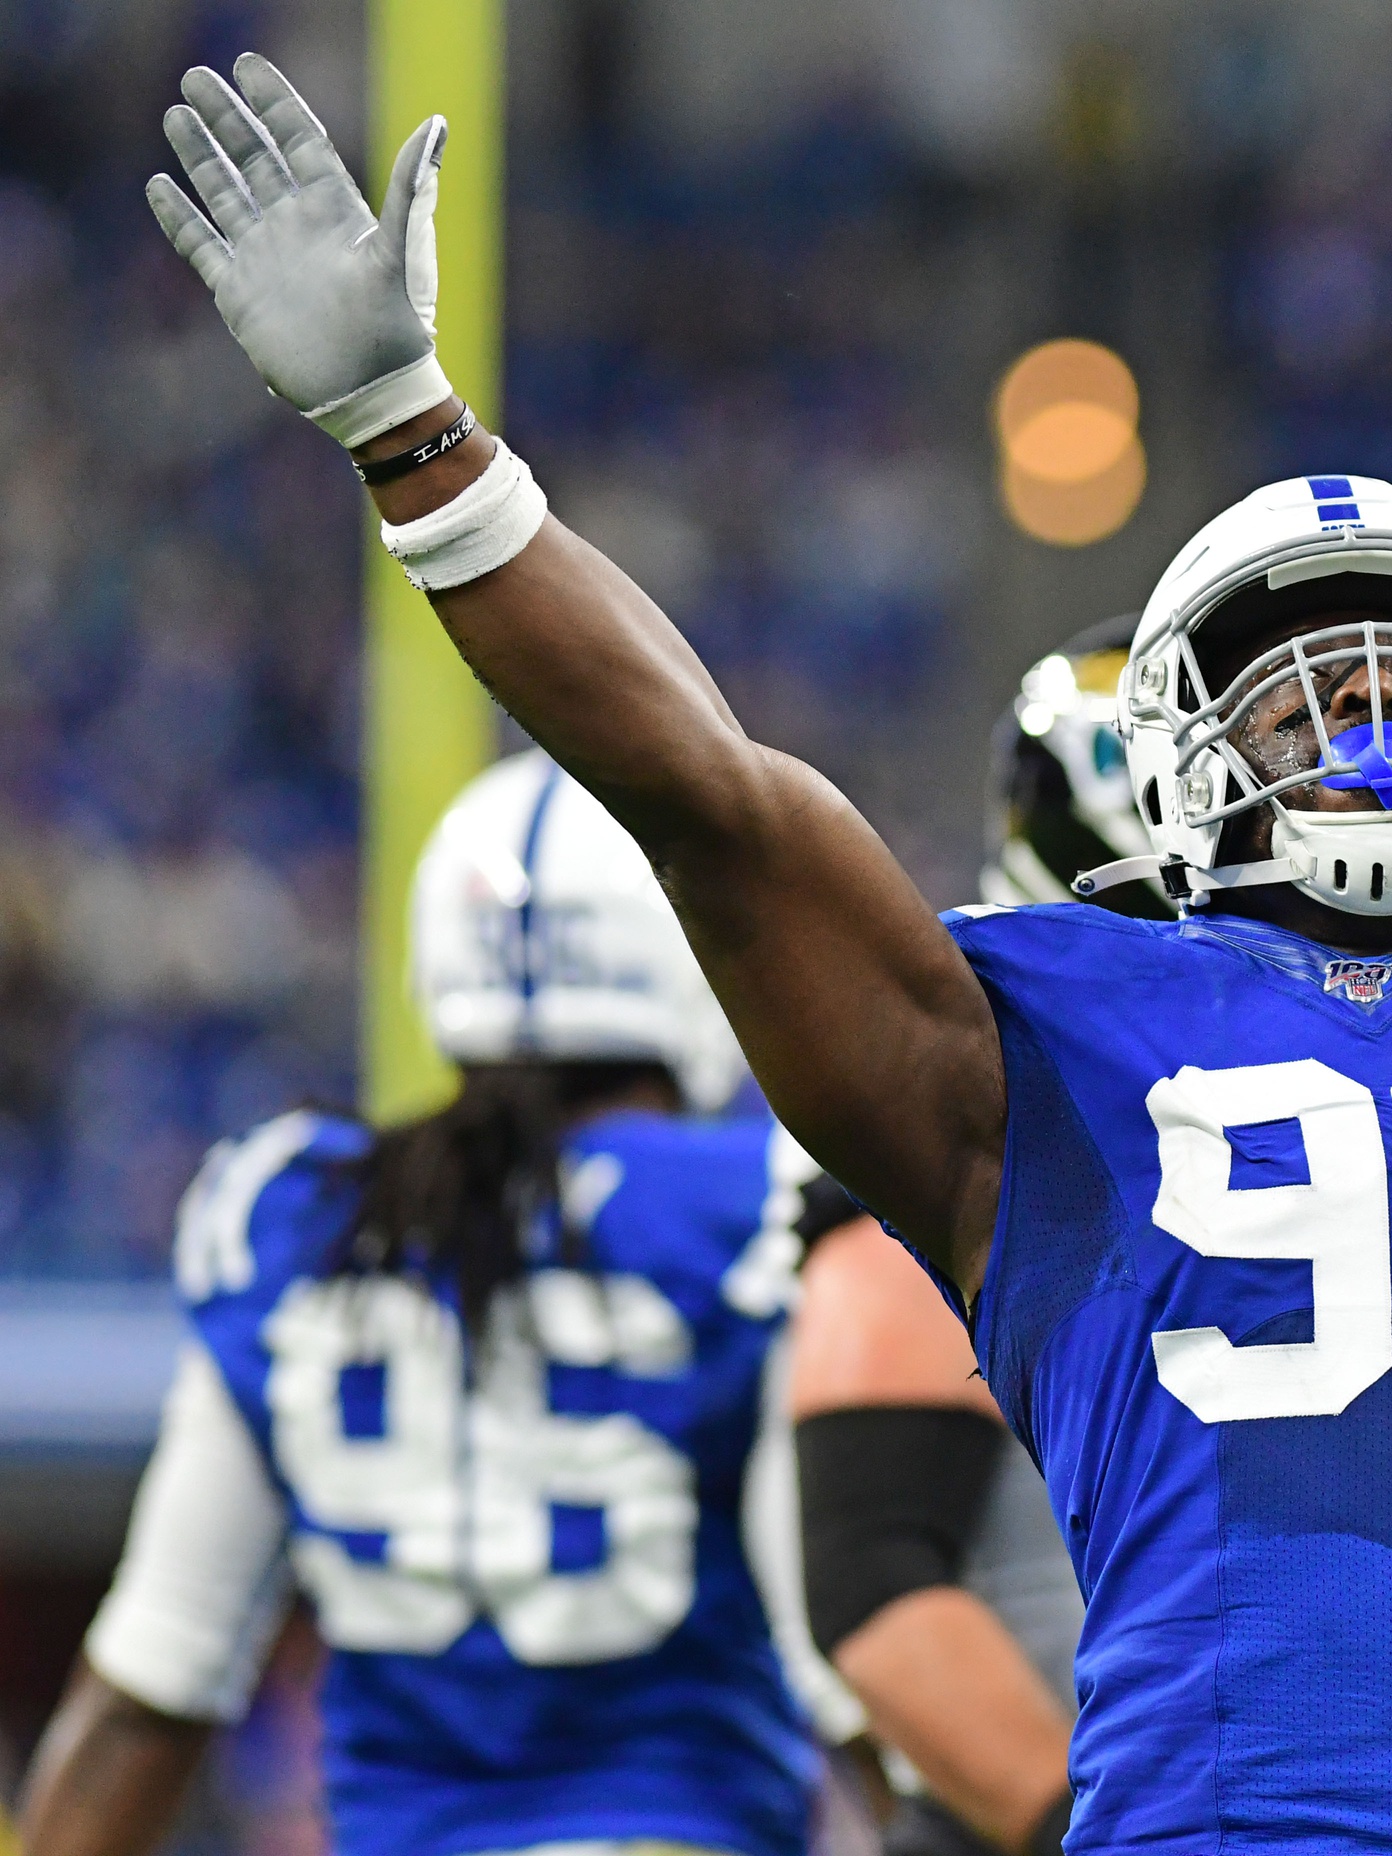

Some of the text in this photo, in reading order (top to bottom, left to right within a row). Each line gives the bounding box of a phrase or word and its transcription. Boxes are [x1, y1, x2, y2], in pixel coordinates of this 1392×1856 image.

[413, 443, 439, 463] I
[440, 432, 463, 452] AM
[1329, 961, 1386, 980] 100
[1352, 984, 1378, 997] NFL
[262, 1267, 698, 1668] 96
